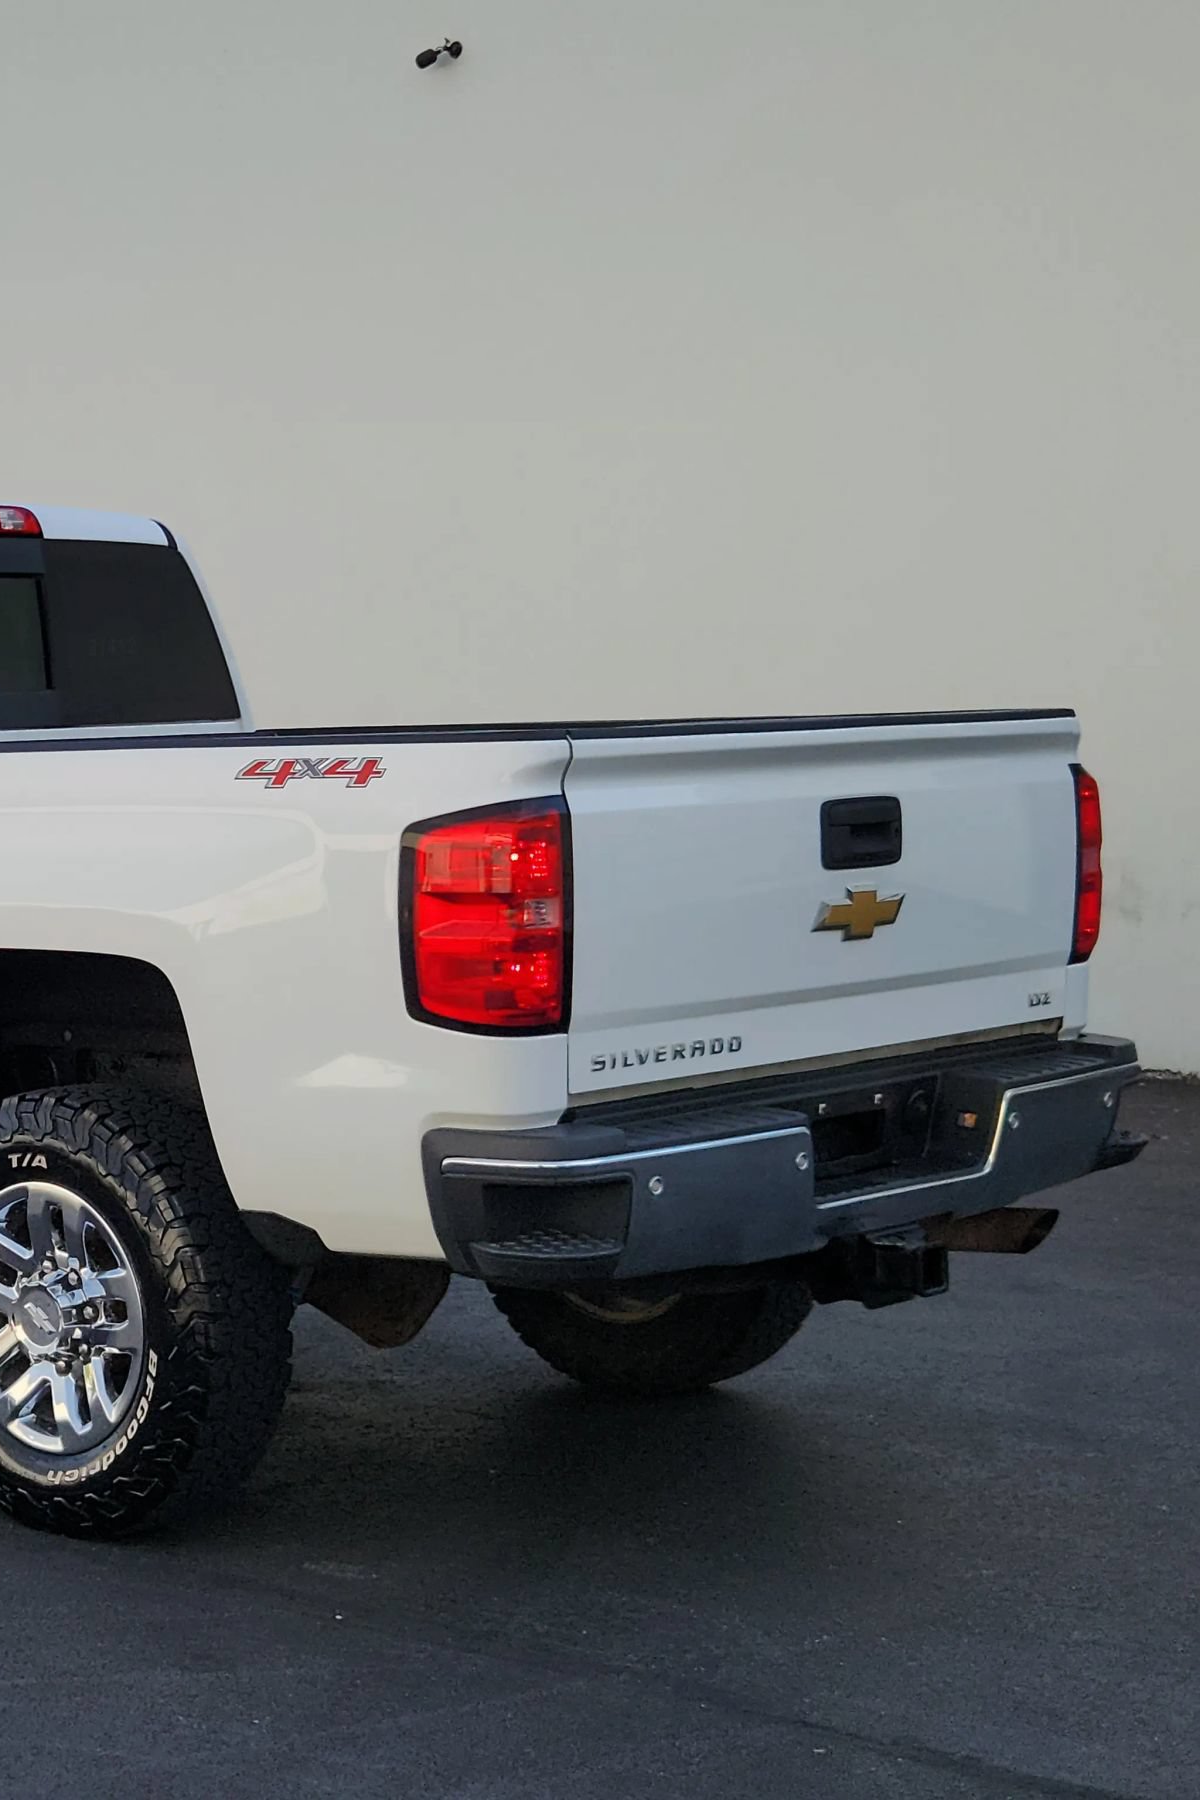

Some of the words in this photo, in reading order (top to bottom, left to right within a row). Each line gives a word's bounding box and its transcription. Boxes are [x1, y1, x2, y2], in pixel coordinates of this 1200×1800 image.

[591, 1036, 742, 1072] SILVERADO
[8, 1152, 48, 1169] T/A
[47, 1349, 158, 1485] BFGoodrich
